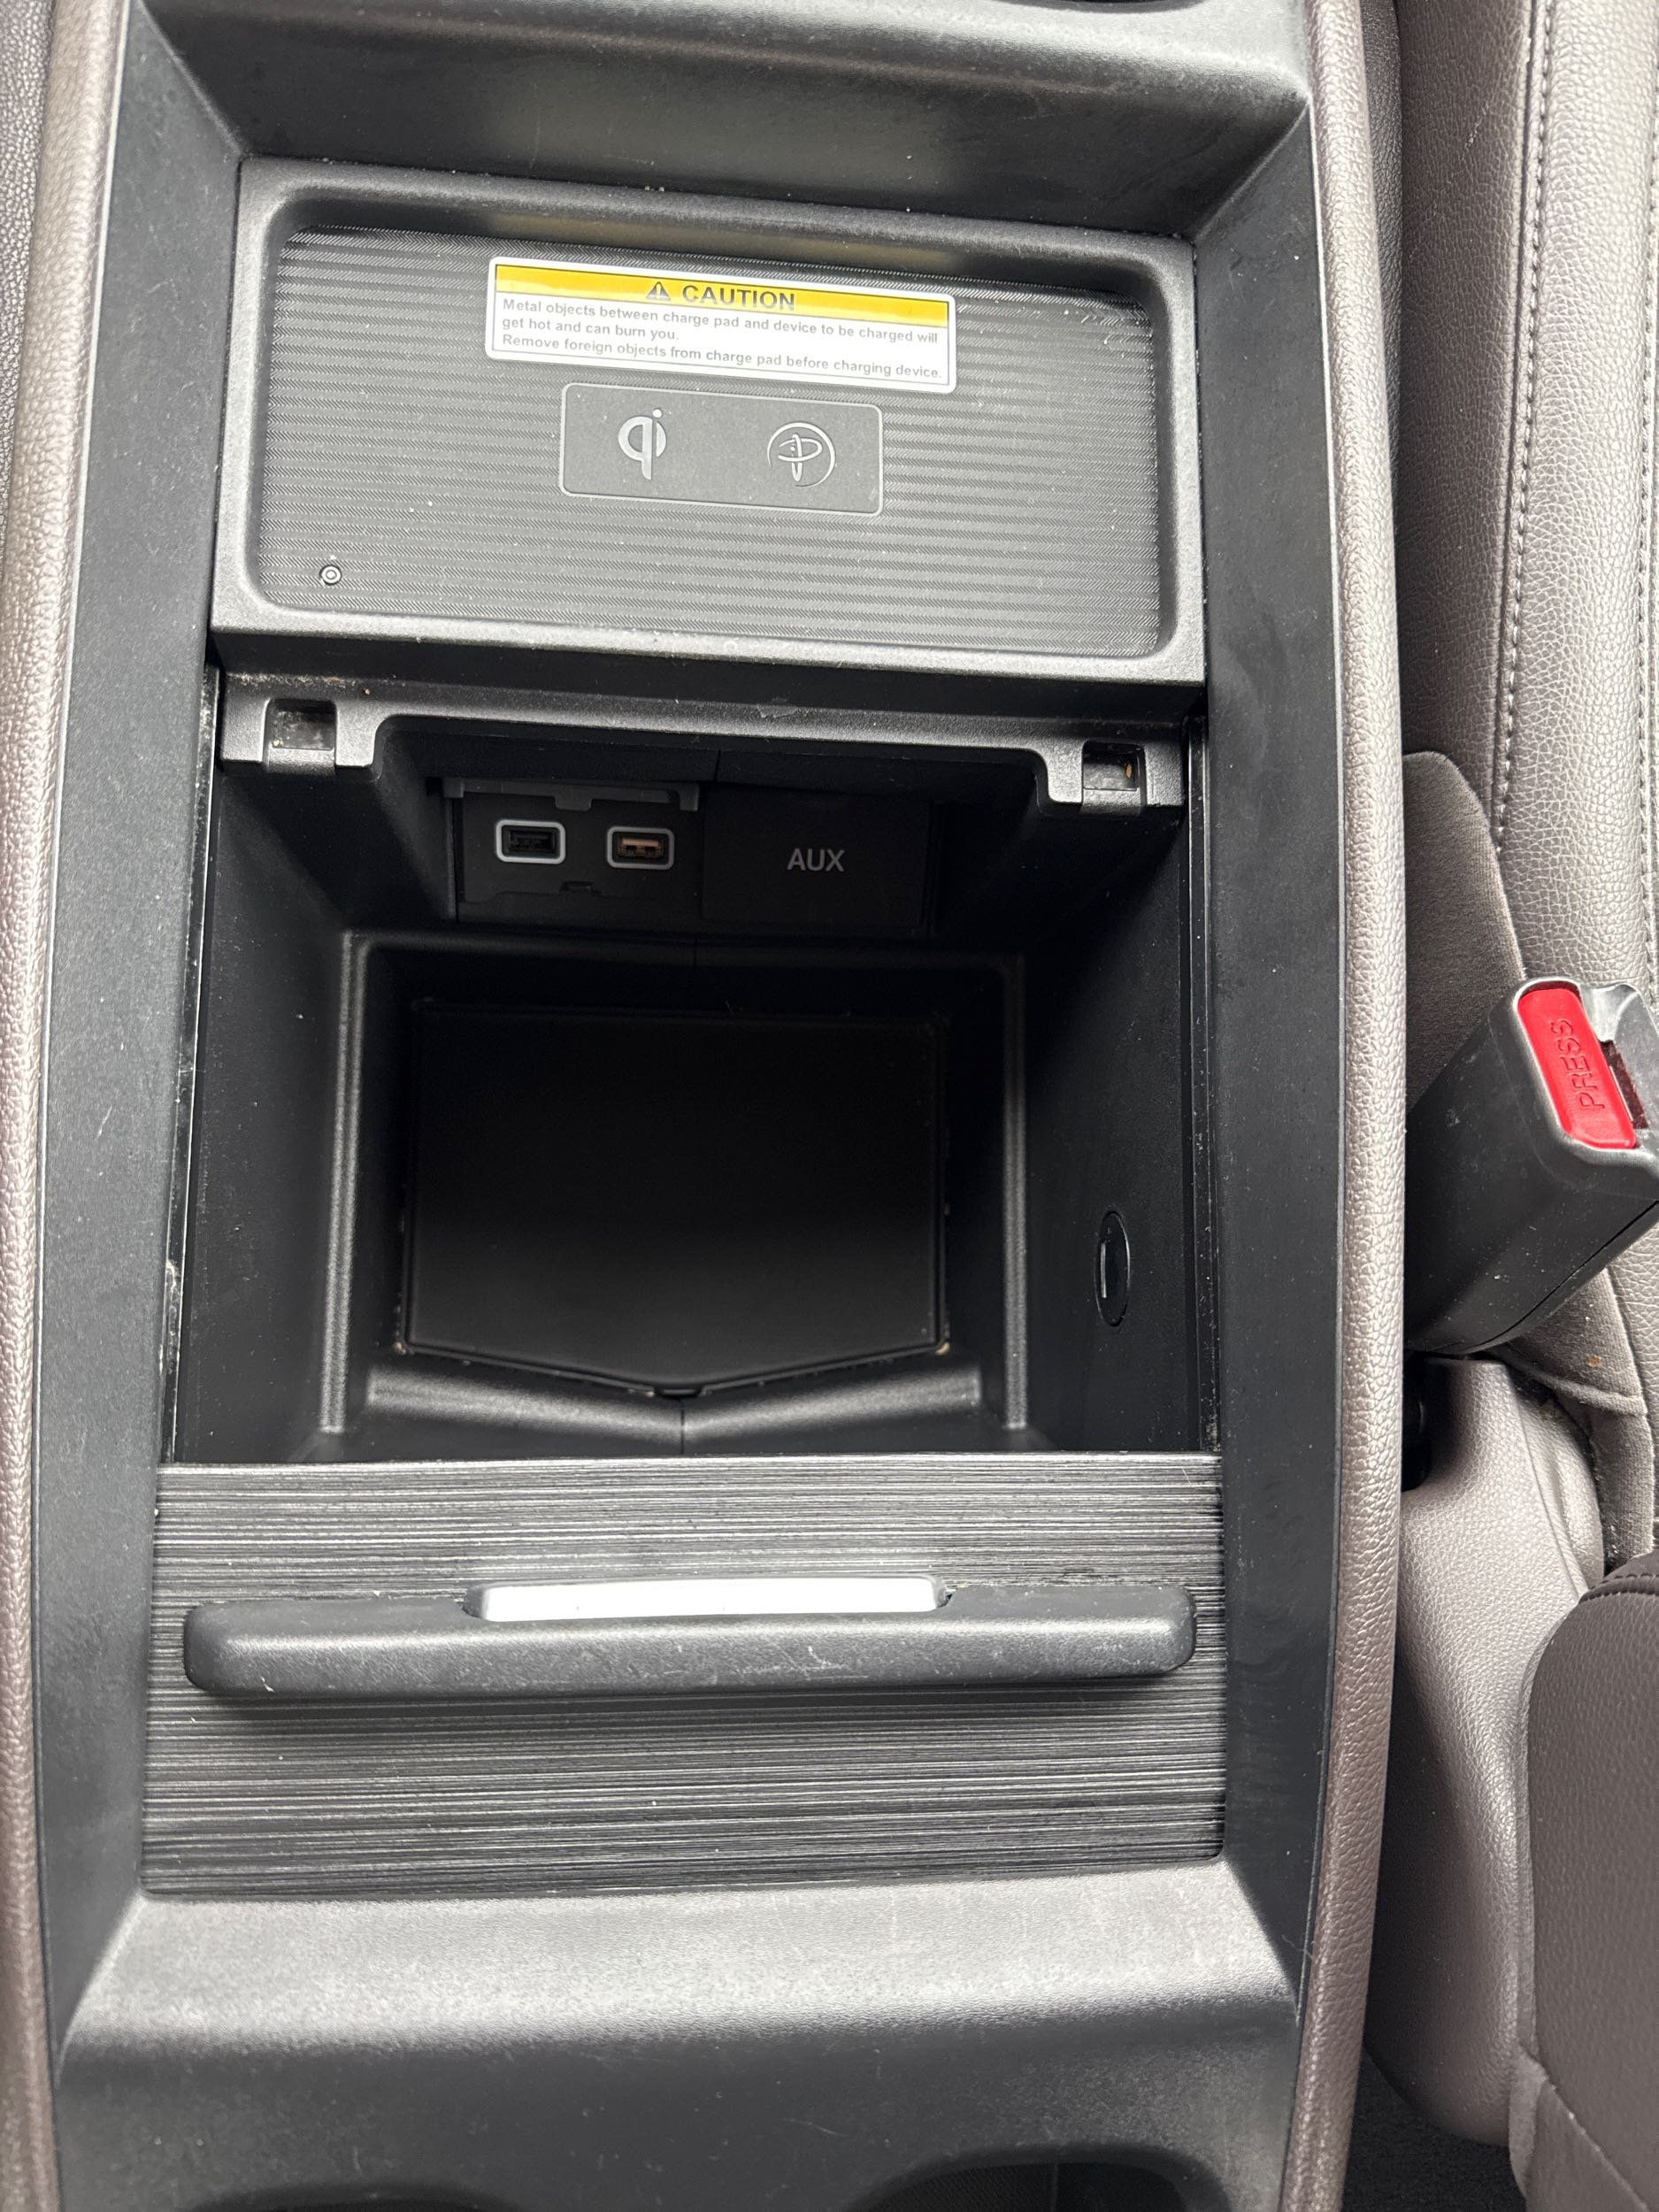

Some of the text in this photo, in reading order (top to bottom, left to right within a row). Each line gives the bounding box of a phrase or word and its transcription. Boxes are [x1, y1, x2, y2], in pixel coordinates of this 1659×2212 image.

[682, 284, 795, 311] CAUTION
[503, 298, 938, 343] Metal objects between charge pad and device to be charged will
[503, 319, 680, 341] get hot and can burn you.
[503, 334, 941, 379] Remove foreign objects from charge pad before charging device.
[787, 847, 845, 873] AUX
[1550, 1019, 1605, 1110] PRESS
